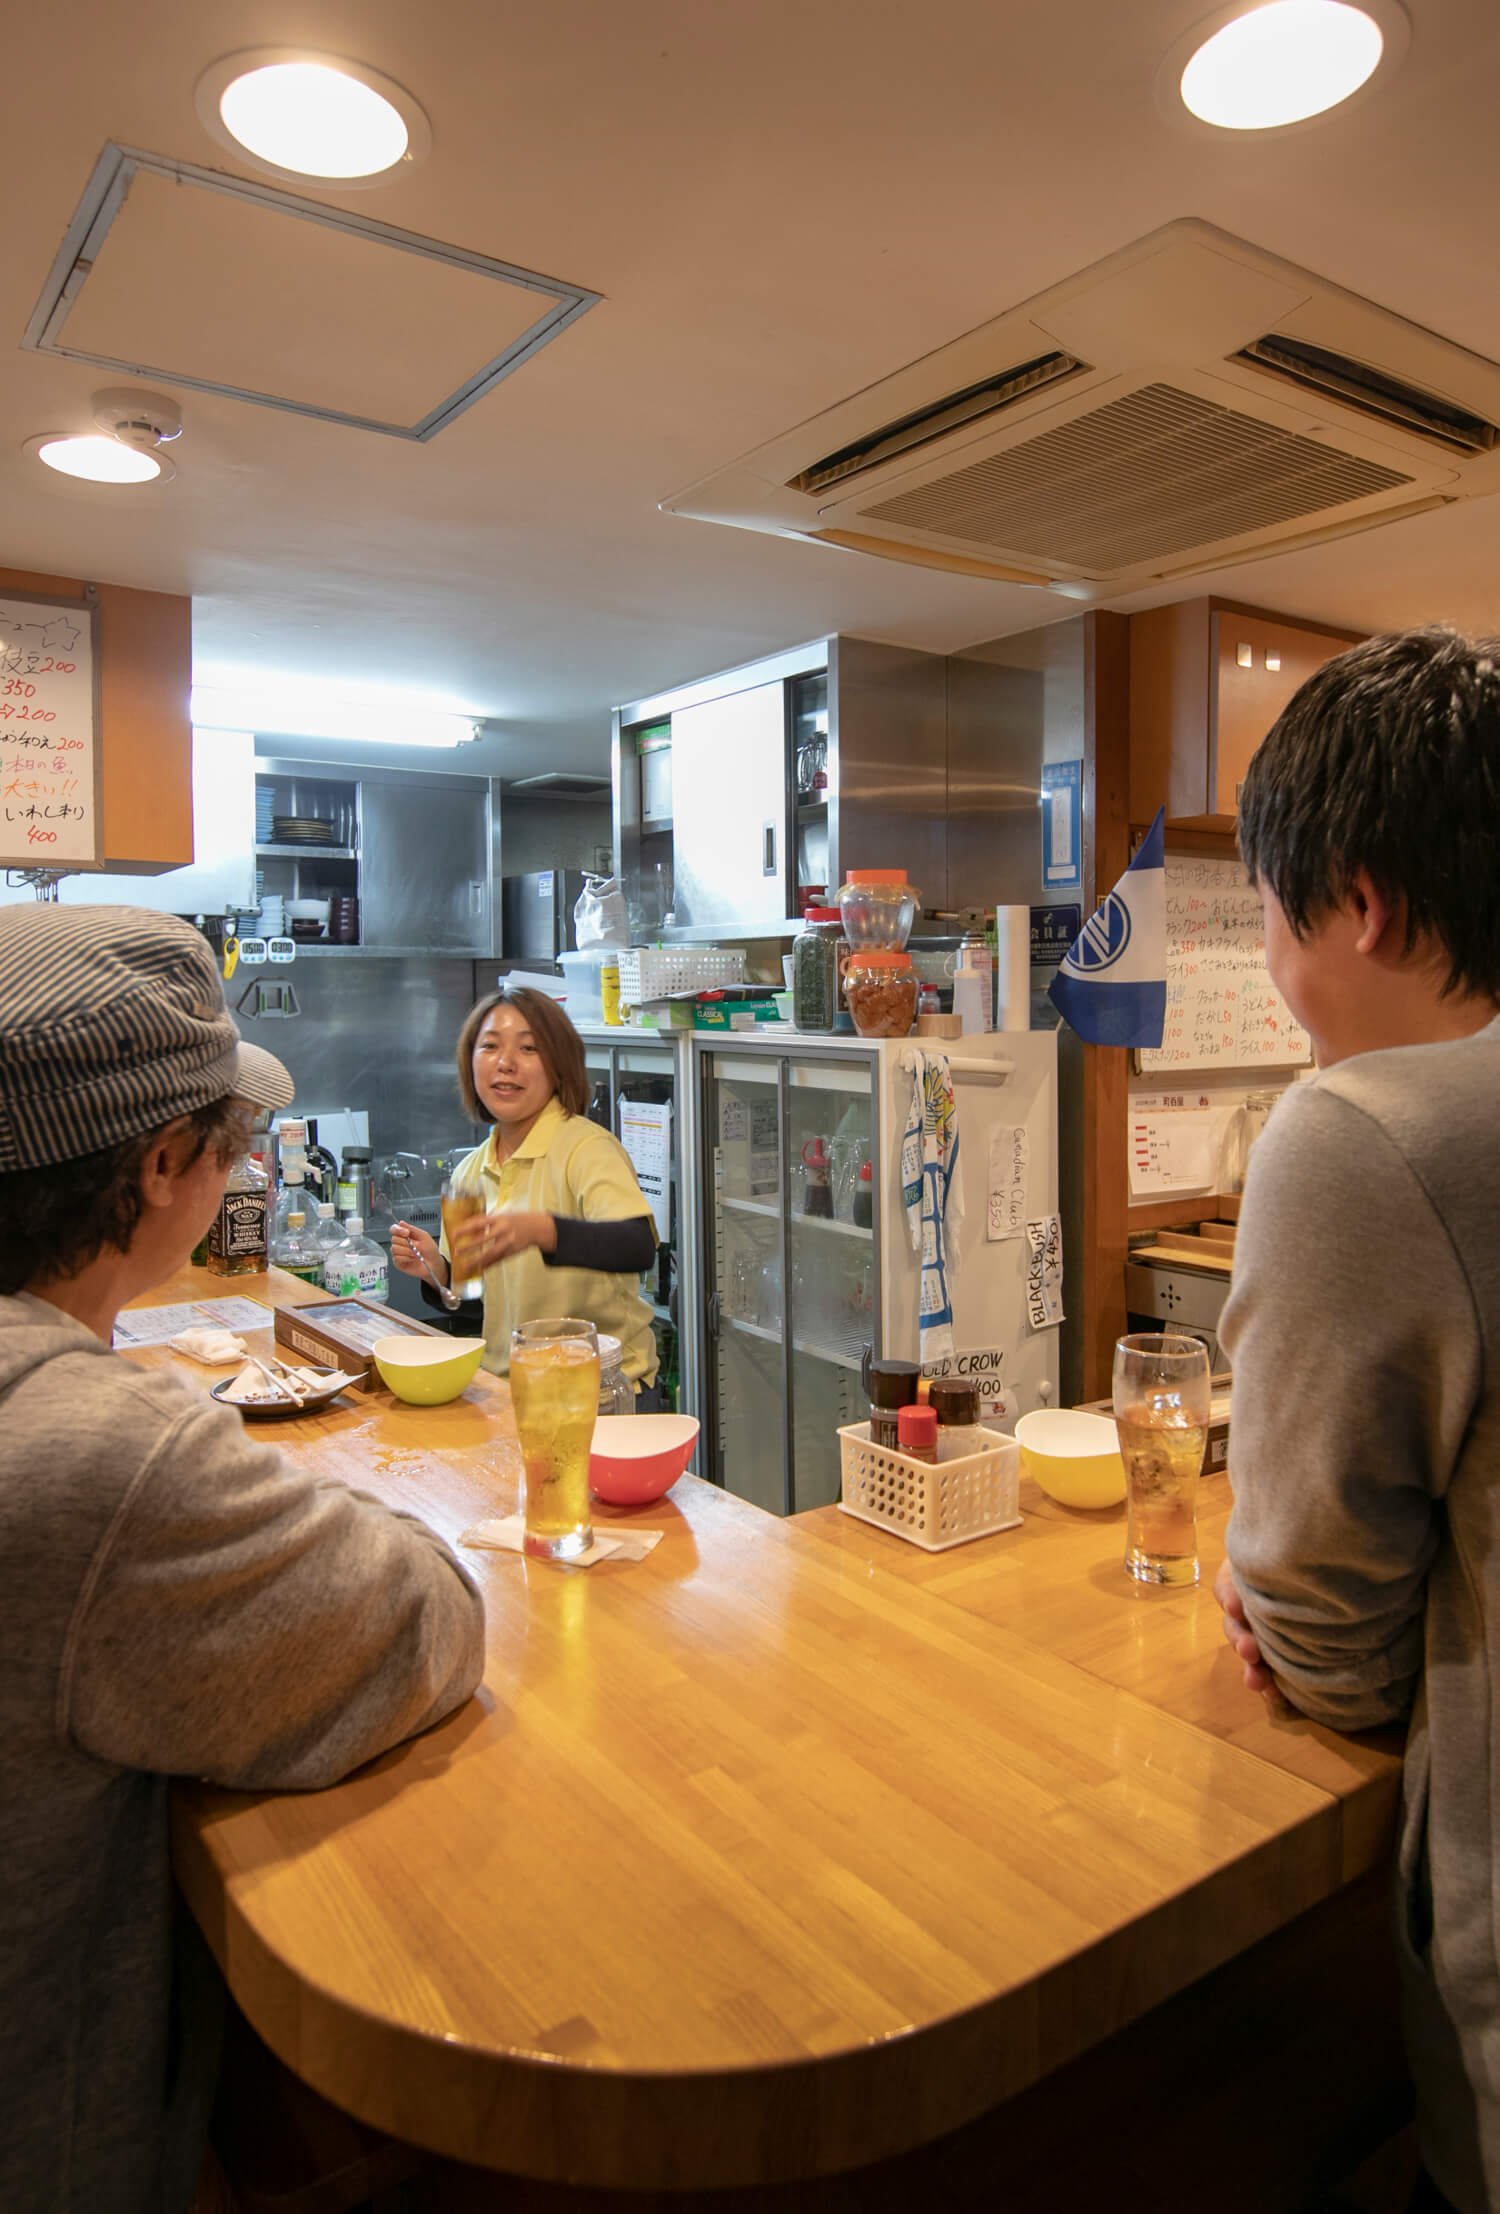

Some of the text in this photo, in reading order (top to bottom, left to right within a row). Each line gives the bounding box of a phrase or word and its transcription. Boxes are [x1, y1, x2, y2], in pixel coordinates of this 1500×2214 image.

[2, 680, 36, 698] 350
[16, 705, 56, 724] 200
[27, 824, 57, 844] 400
[957, 1351, 1004, 1375] CROW
